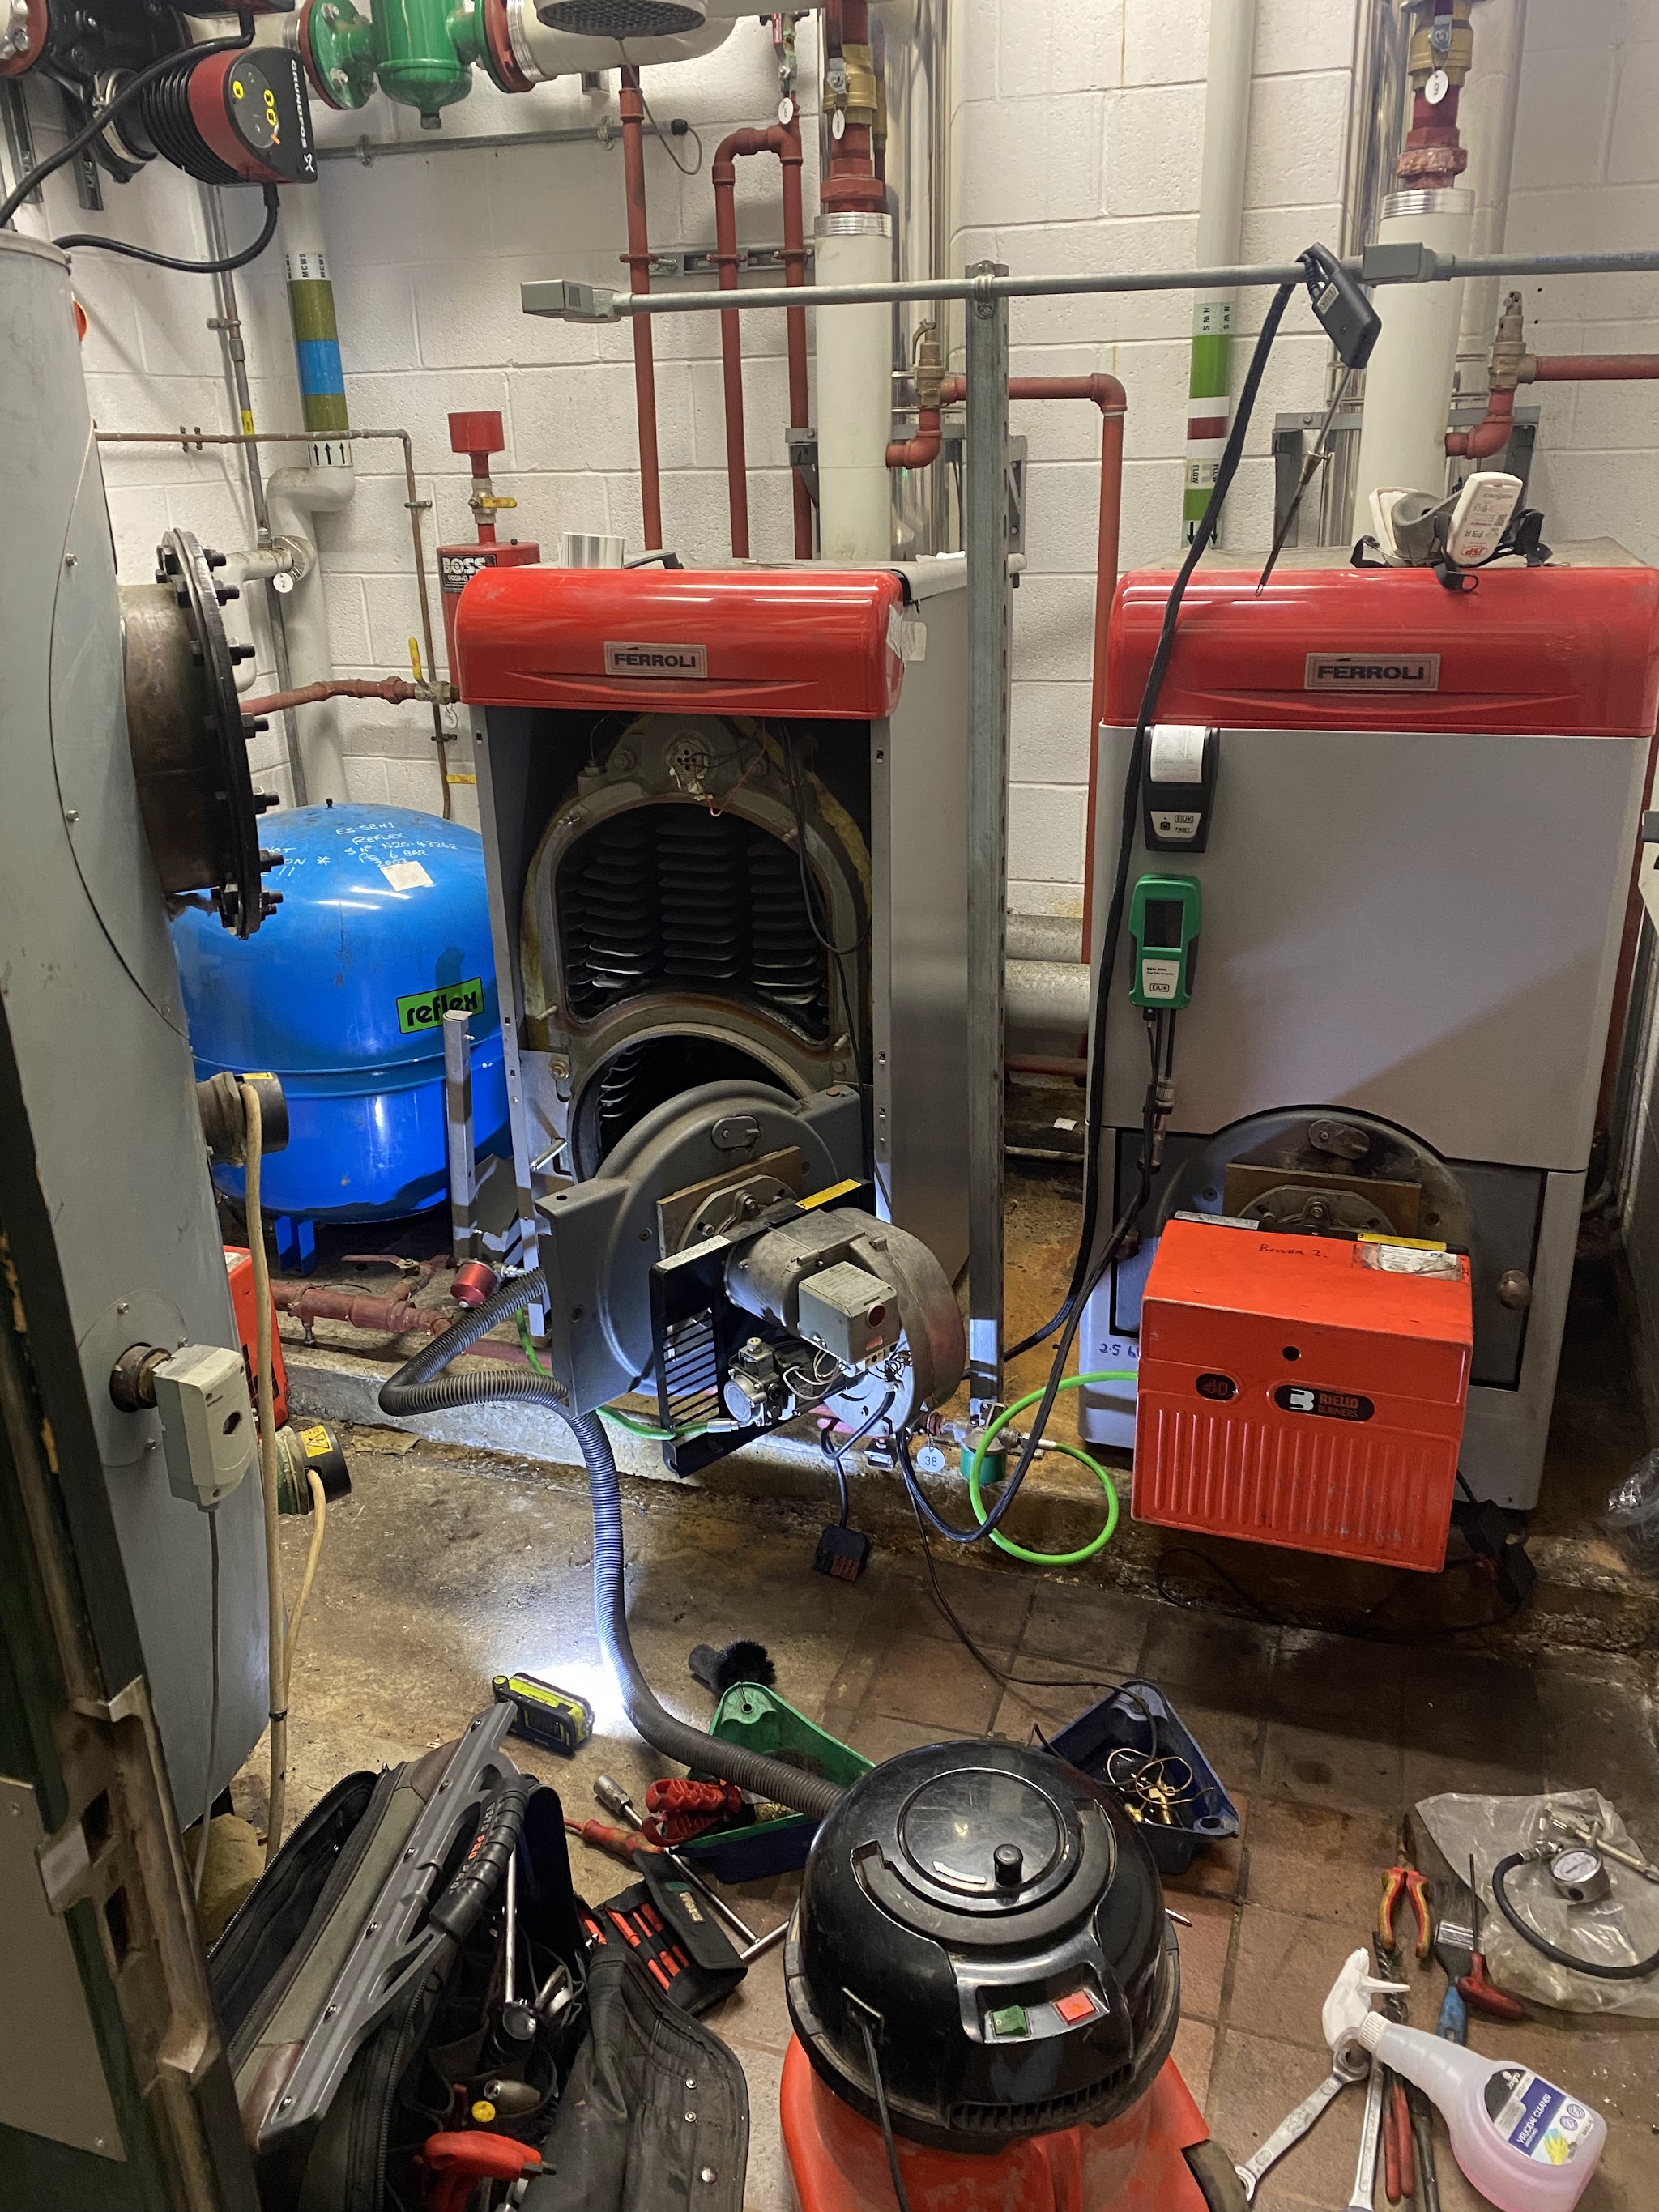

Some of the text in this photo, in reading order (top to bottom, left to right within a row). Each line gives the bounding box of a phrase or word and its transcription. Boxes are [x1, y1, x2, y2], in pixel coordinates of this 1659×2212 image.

[291, 59, 307, 148] GRUNDFOS
[299, 253, 309, 278] MCWS
[1465, 548, 1486, 558] JSP
[441, 557, 487, 575] BOSS
[280, 580, 286, 589] 2
[614, 653, 696, 668] FERROLI
[1318, 665, 1424, 680] FERROLI
[352, 833, 407, 846] REFLEX
[390, 850, 399, 859] 6
[403, 849, 430, 857] BAR
[376, 857, 408, 868] 2003
[407, 991, 478, 1026] reflex
[1202, 1379, 1228, 1396] 40
[1319, 1392, 1359, 1409] RIELLO
[1317, 1404, 1358, 1418] BURNERS
[924, 1455, 937, 1467] 38
[467, 1834, 485, 1860] PRO
[1516, 2093, 1553, 2145] VIRUCIDAL CLEANER
